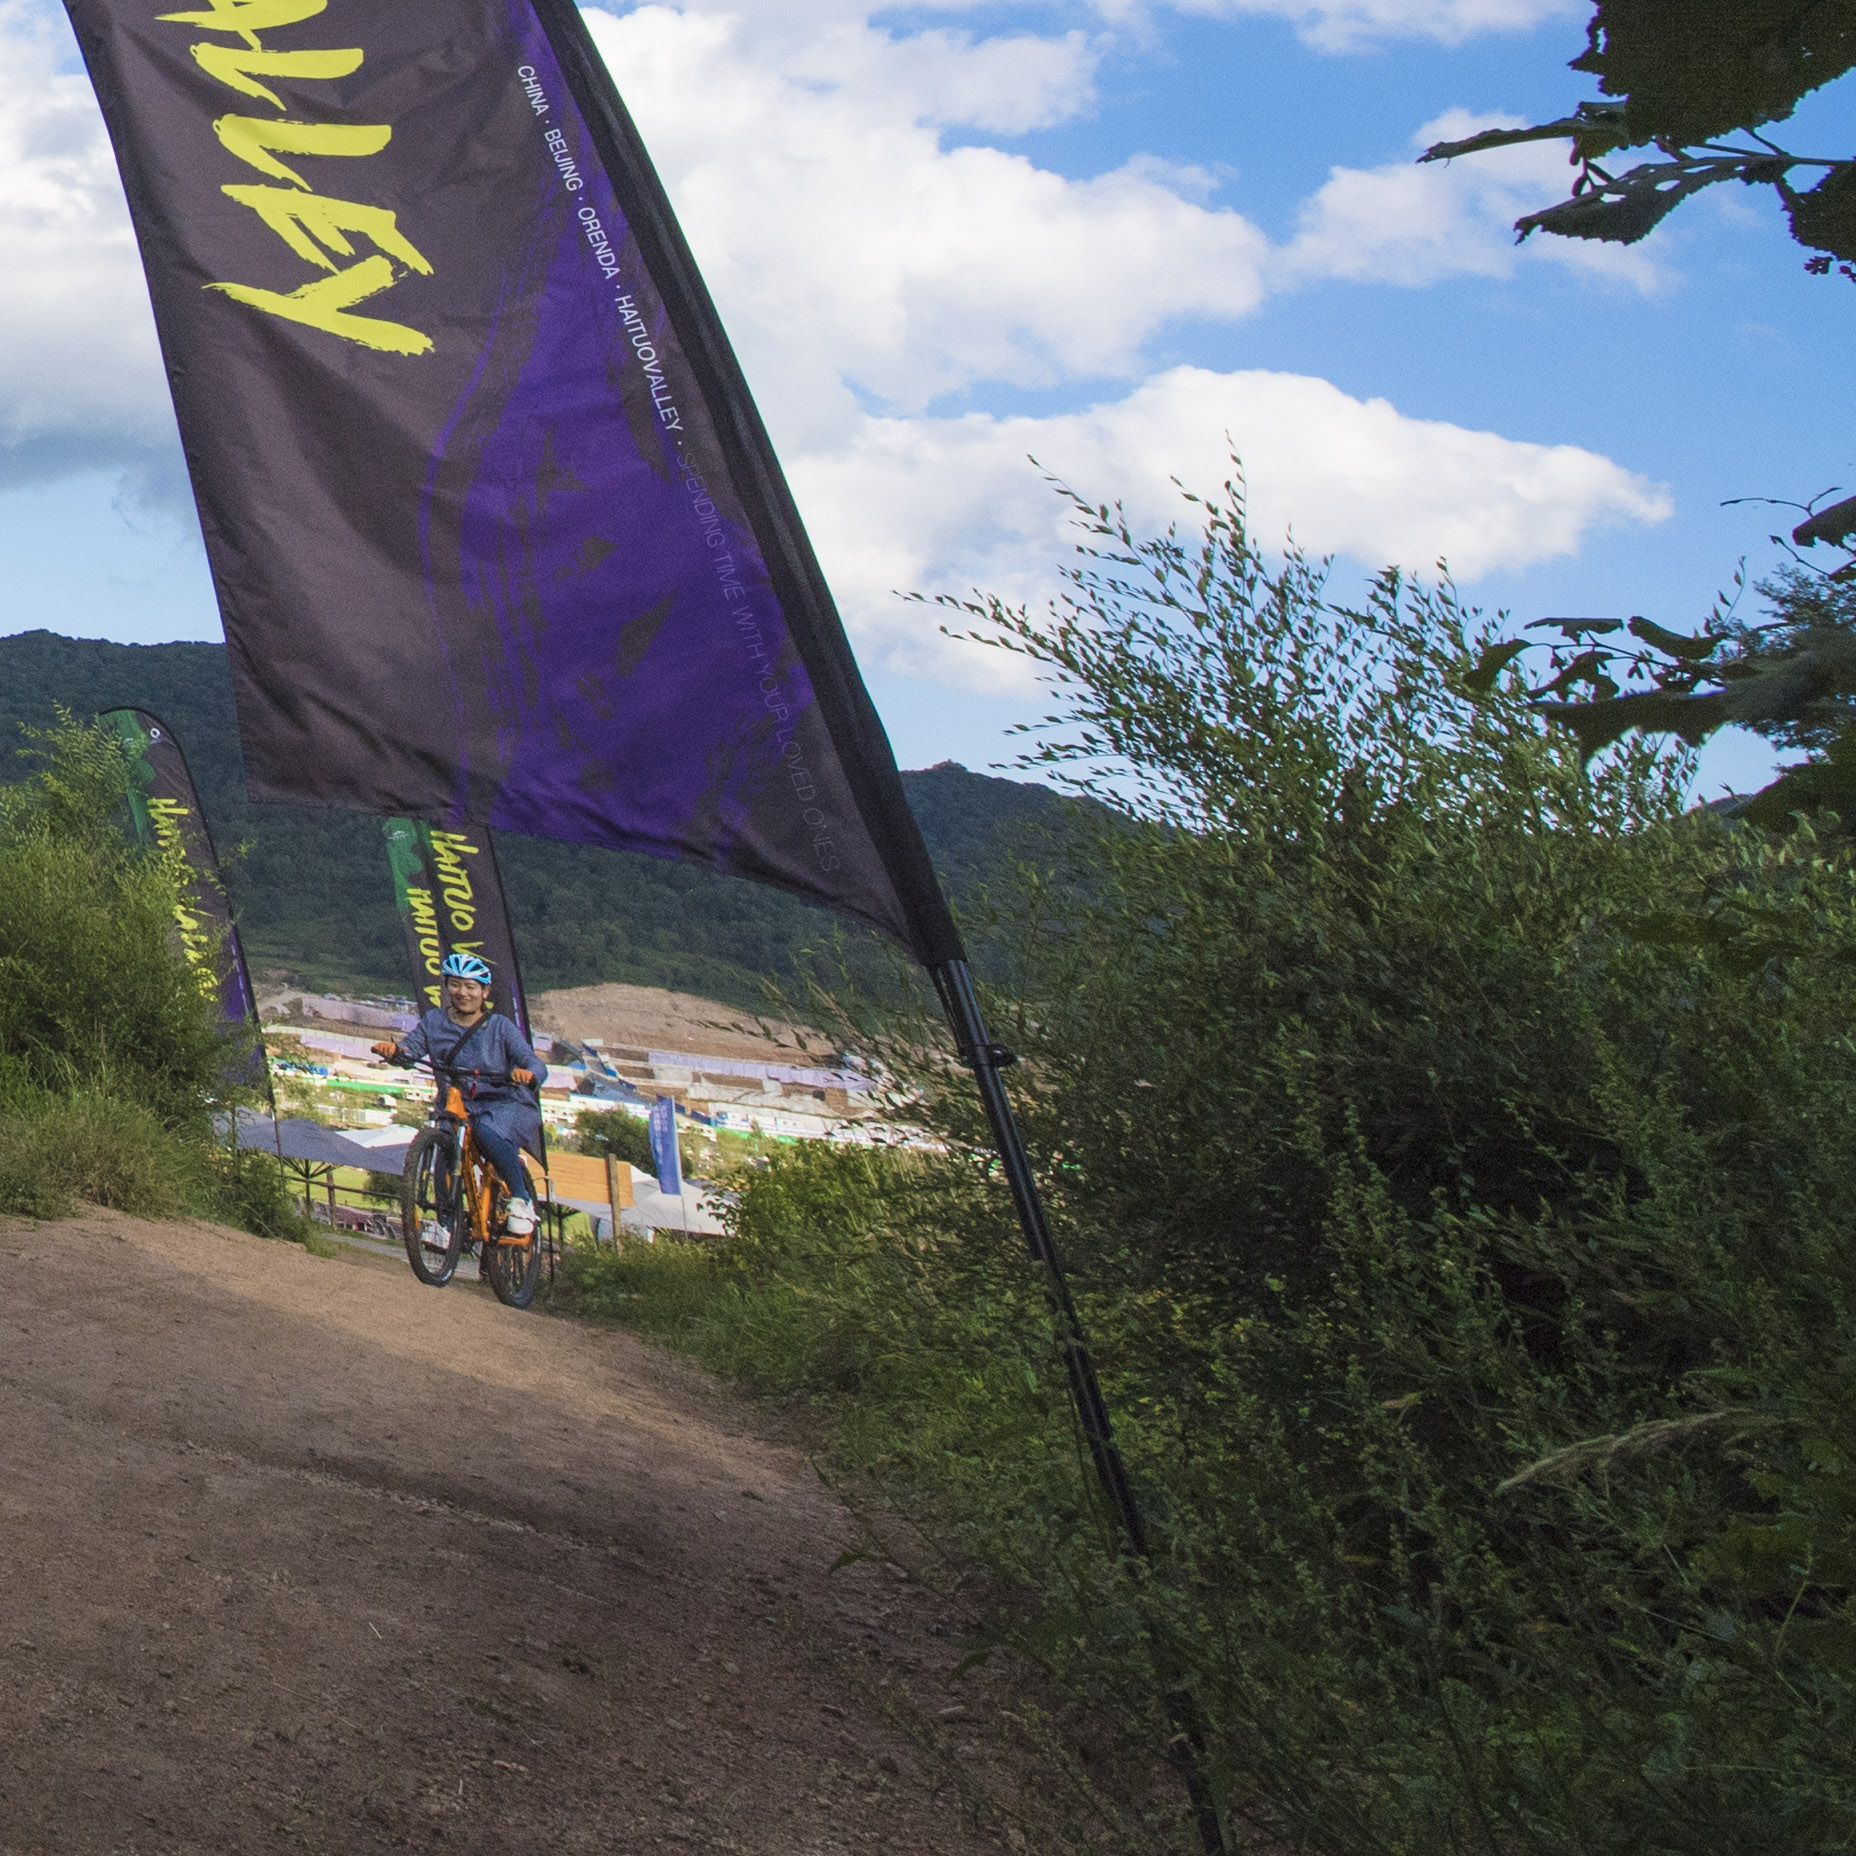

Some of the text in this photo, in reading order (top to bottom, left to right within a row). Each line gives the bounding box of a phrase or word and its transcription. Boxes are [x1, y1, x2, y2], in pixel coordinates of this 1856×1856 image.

[517, 64, 840, 873] CHINA BEIJING ORENDA HAITUOVALLEY SPENDING TIME WITH YOUR LOVED ONES
[430, 830, 479, 932] HAITUO
